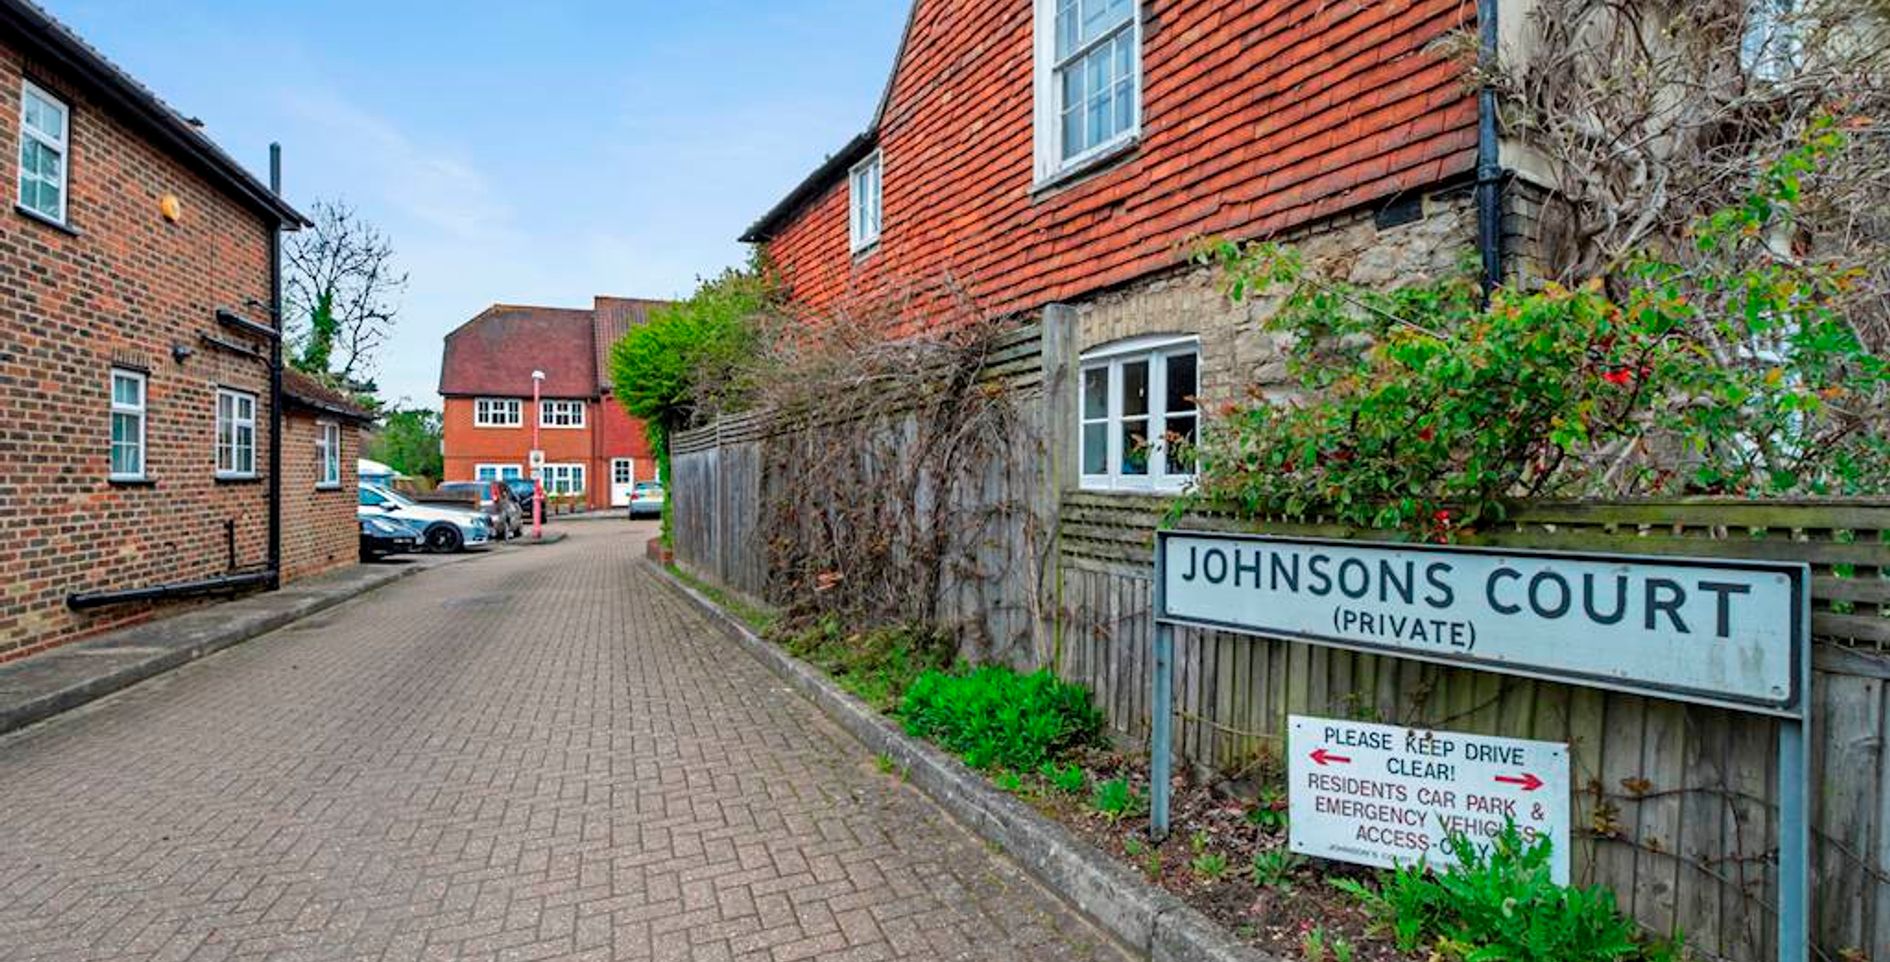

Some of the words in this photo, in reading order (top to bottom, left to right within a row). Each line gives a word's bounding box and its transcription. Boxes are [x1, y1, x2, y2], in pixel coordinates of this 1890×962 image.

[1182, 547, 1455, 609] JOHNSONS
[1485, 567, 1751, 638] COURT
[1333, 605, 1476, 651] (PRIVATE)
[1324, 727, 1392, 750] PLEASE
[1405, 734, 1455, 757] KEEP
[1465, 743, 1525, 766] DRIVE
[1387, 758, 1455, 781] CLEAR!
[1308, 773, 1408, 802] RESIDENTS
[1417, 787, 1456, 809] CAR
[1467, 794, 1516, 817] PARK
[1530, 802, 1545, 820] &
[1315, 797, 1428, 827] EMERGENCY
[1356, 825, 1489, 859] ACCESS-OY
